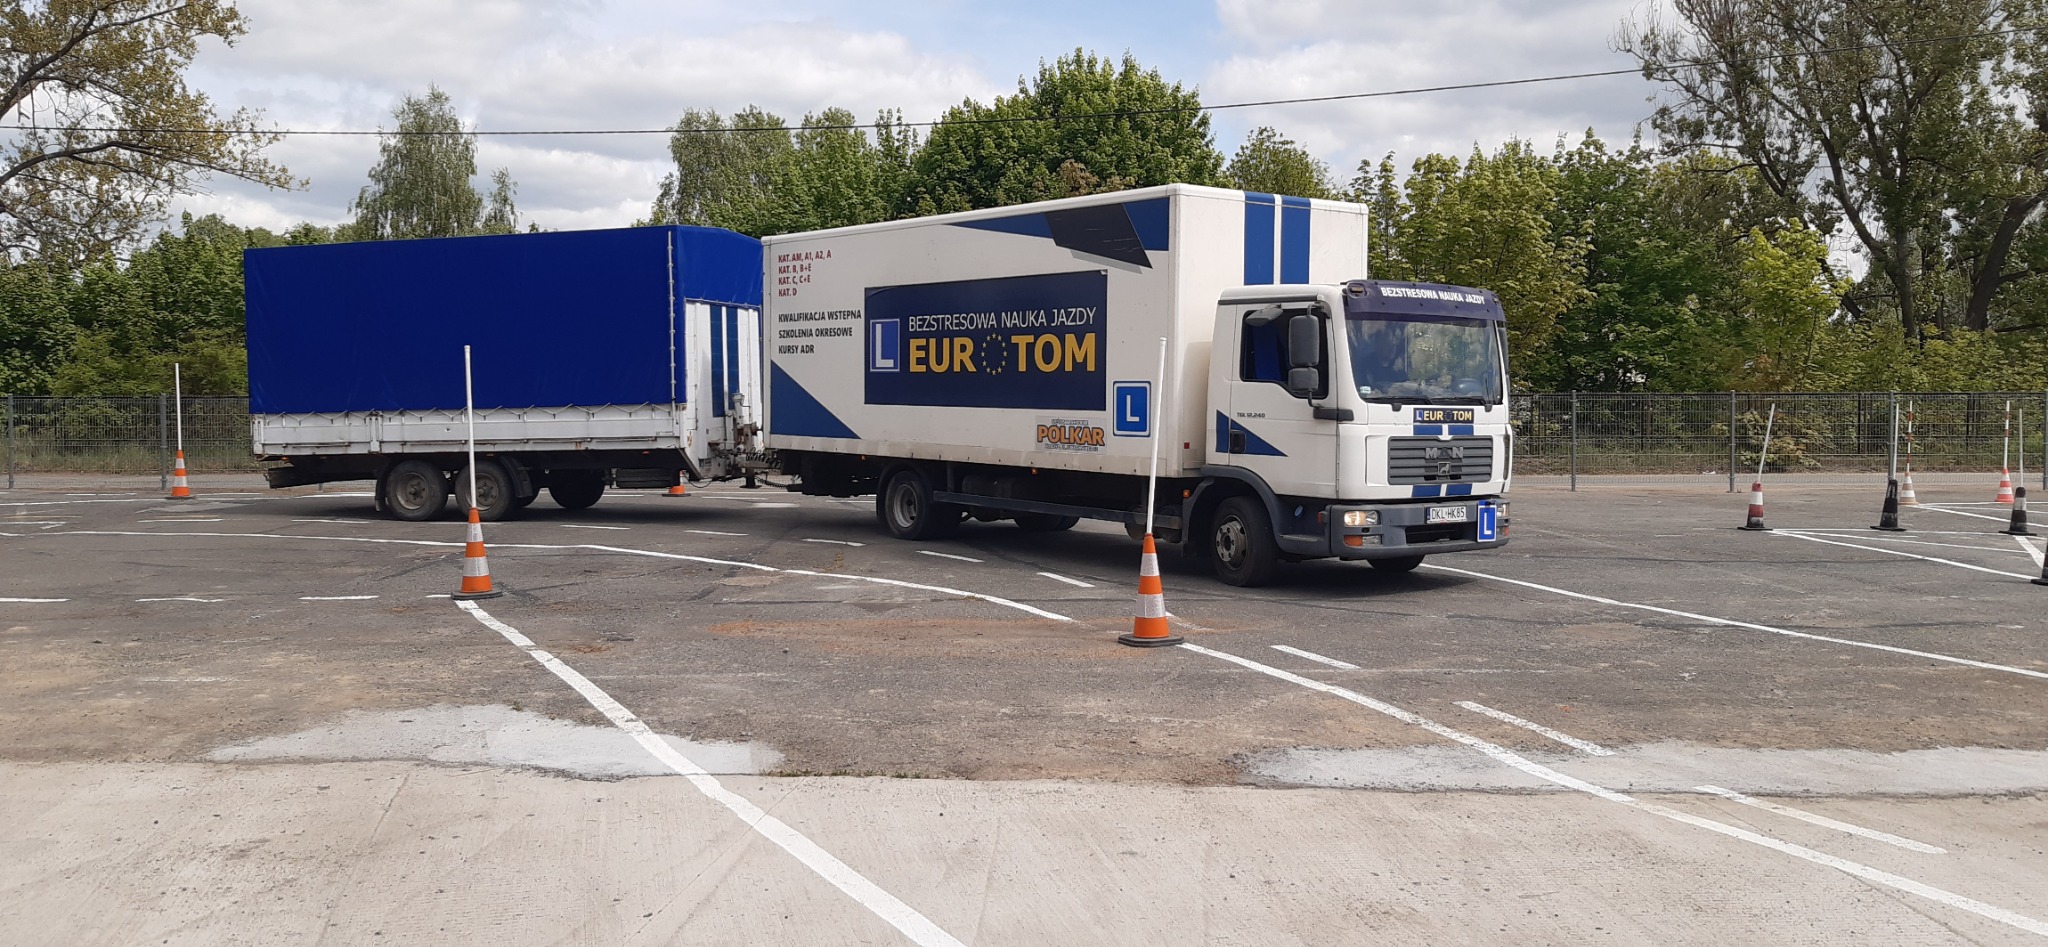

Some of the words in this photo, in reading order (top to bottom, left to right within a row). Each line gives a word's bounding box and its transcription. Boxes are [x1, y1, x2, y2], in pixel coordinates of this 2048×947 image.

[826, 250, 832, 259] A
[778, 265, 791, 274] KAT.
[800, 263, 812, 272] B+E
[778, 276, 791, 285] KAT.
[799, 274, 811, 283] C+E
[778, 288, 791, 297] KAT.
[792, 287, 798, 296] D
[1381, 287, 1438, 299] BEZSTRESOWA
[1439, 291, 1464, 302] NAUKA
[1465, 294, 1485, 304] JAZDY
[778, 312, 825, 322] KWALIFIKACJA
[908, 312, 997, 332] BEZSTRESOWA
[1001, 309, 1047, 329] NAUKA
[1050, 306, 1097, 327] JAZDY
[778, 328, 814, 339] SZKOLENIA
[815, 327, 853, 337] OKRESOWE
[778, 344, 799, 354] KURSY
[800, 344, 815, 354] ADR
[875, 323, 894, 368] L
[1011, 332, 1096, 372] TOM
[1126, 394, 1140, 422] L
[1452, 410, 1472, 421] TOM
[1037, 424, 1106, 447] POLKAR
[1425, 446, 1464, 459] MAN
[1431, 508, 1446, 520] DKL
[1484, 512, 1492, 535] L
